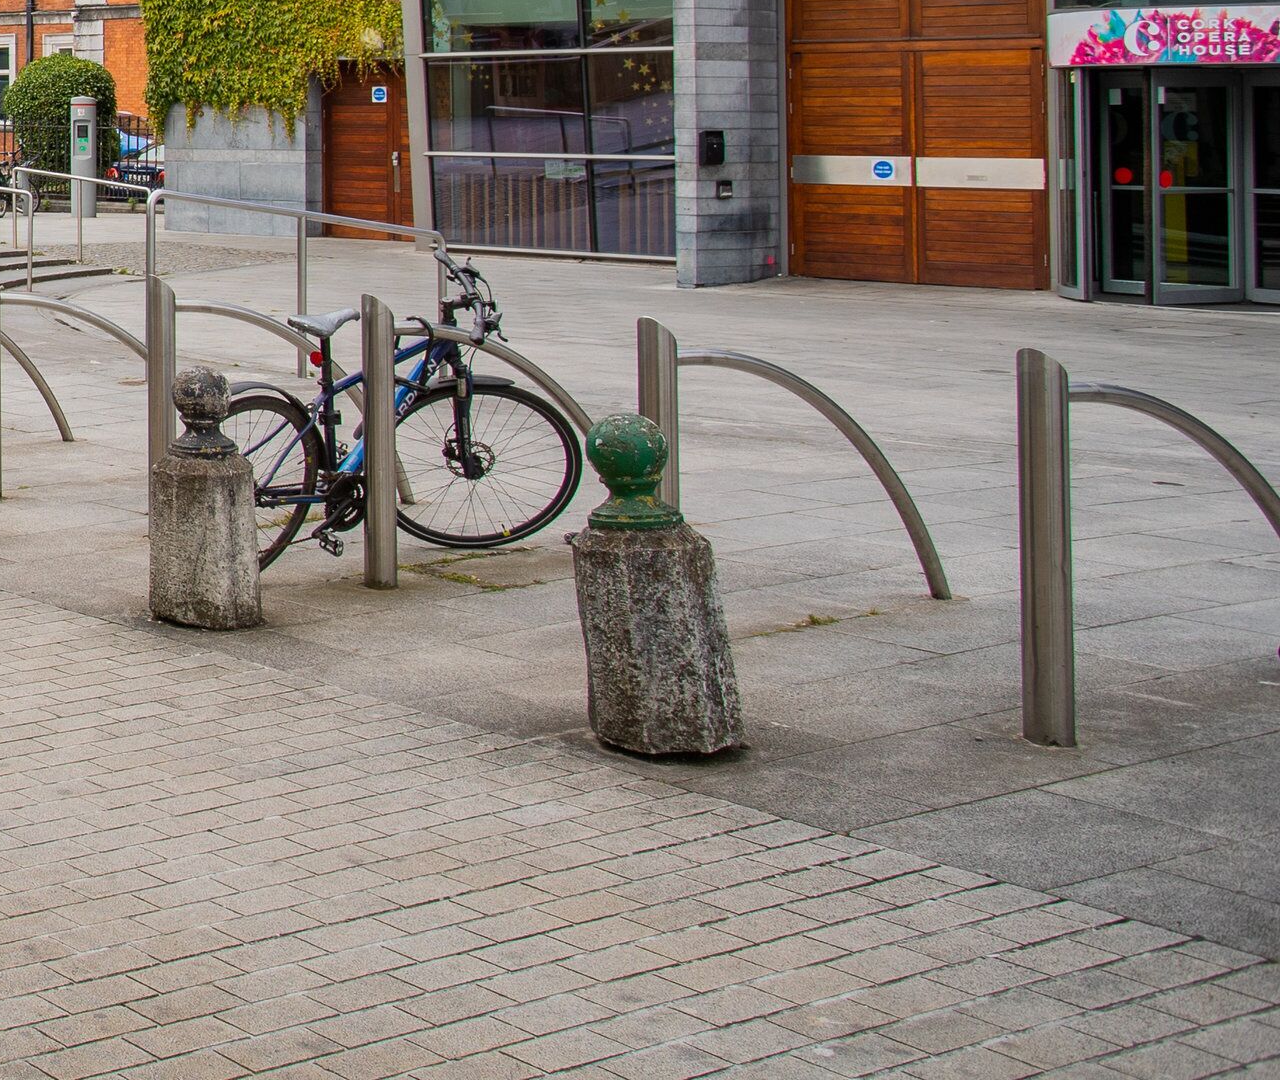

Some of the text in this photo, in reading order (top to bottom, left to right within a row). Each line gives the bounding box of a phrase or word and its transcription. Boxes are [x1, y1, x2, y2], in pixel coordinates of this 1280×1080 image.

[1176, 18, 1237, 30] CORK
[1176, 31, 1252, 43] OPERA
[1178, 44, 1252, 56] HOUSE
